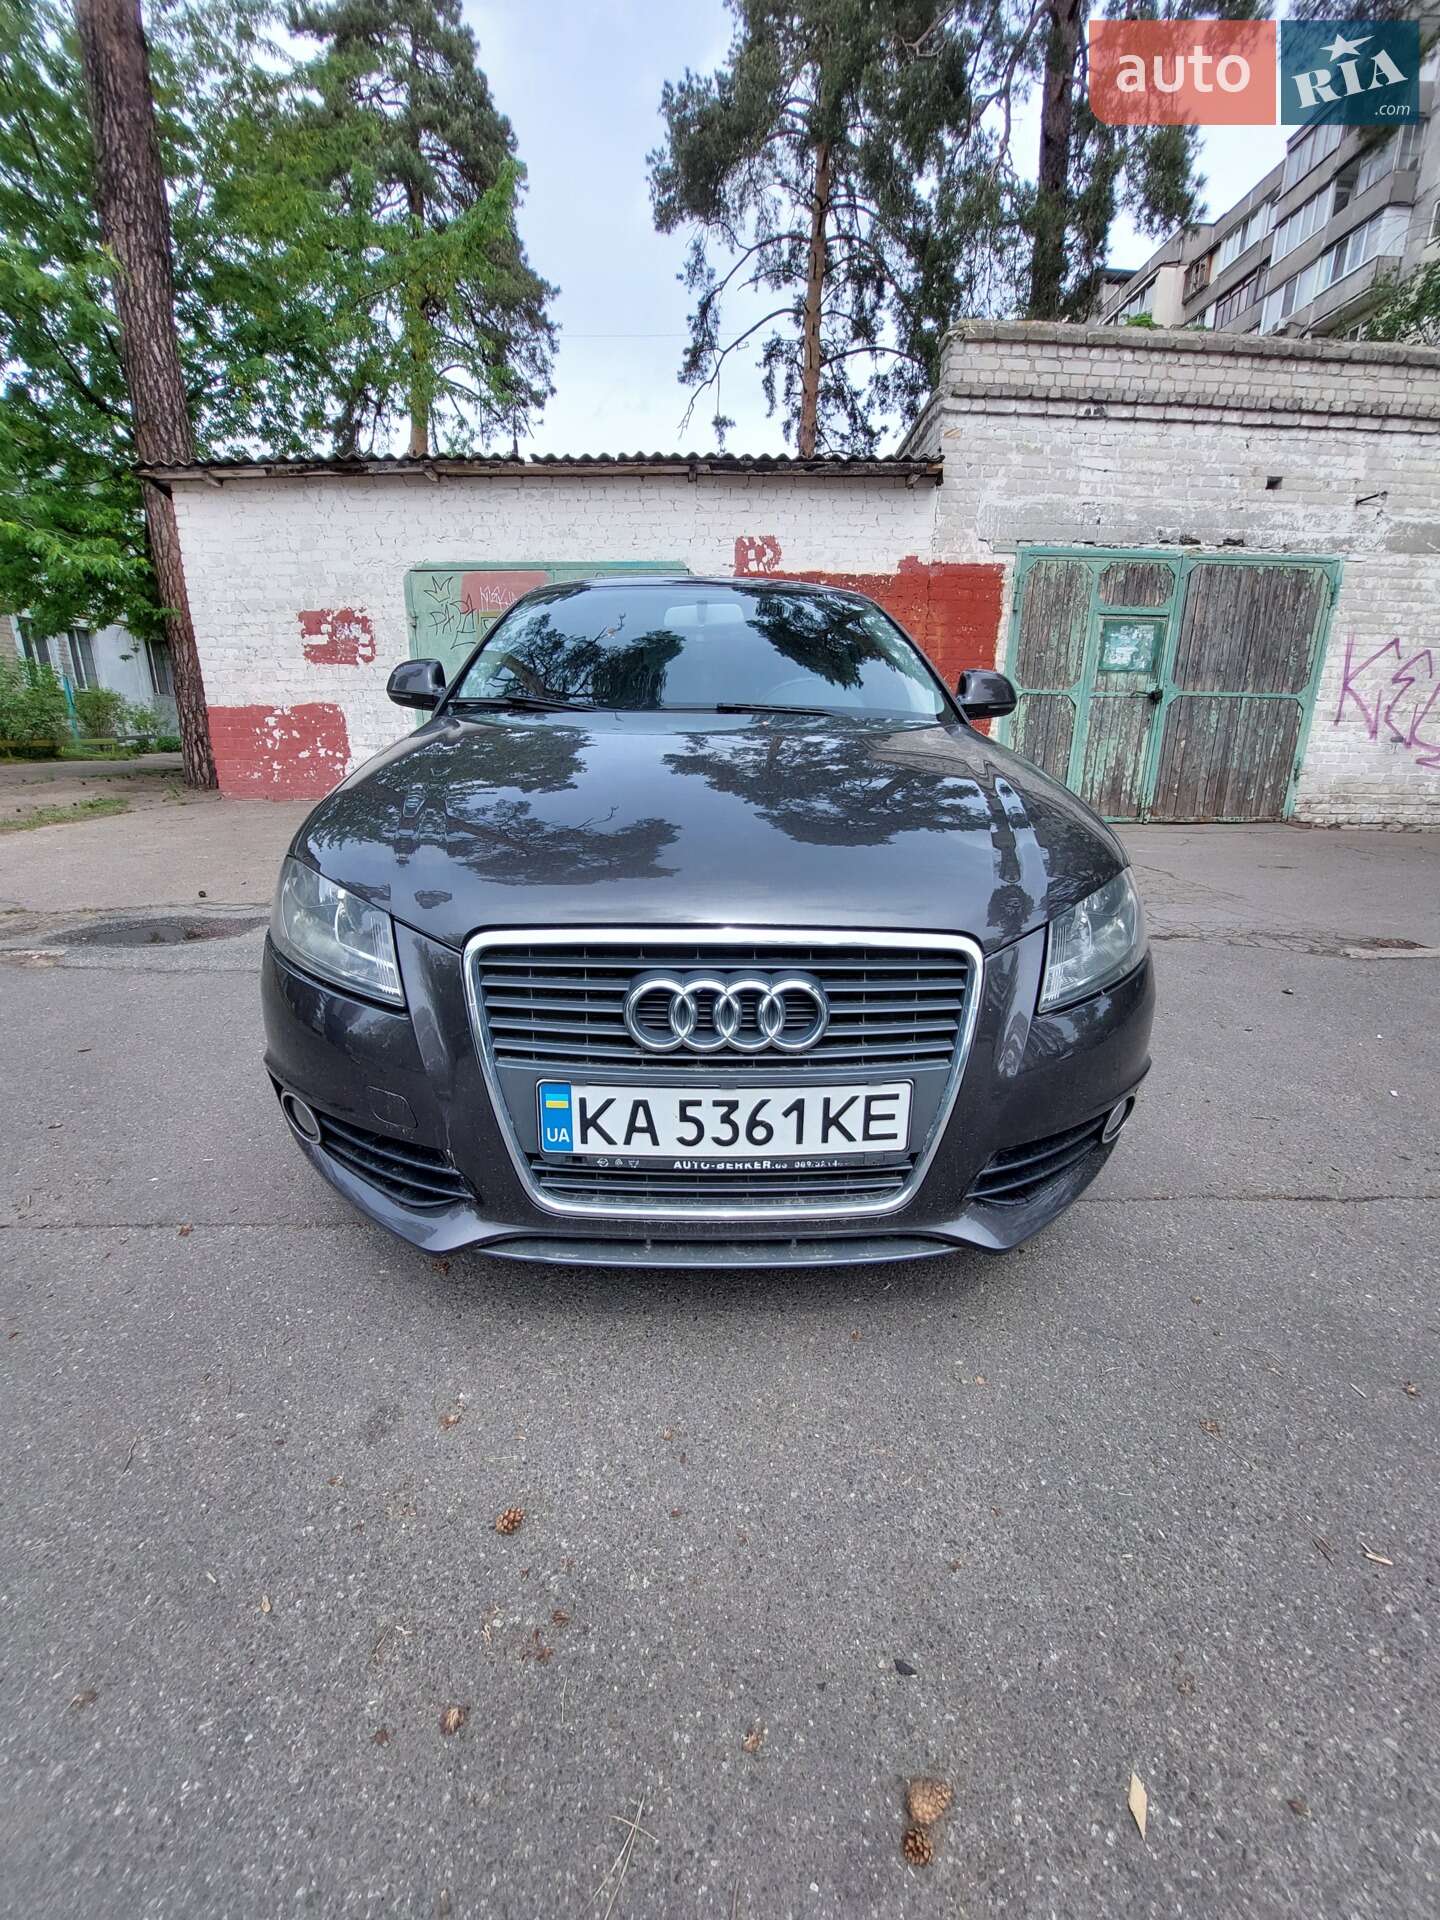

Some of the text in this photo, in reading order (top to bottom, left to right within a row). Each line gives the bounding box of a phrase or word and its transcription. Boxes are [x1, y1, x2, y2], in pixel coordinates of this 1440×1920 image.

[546, 1127, 570, 1143] UA
[578, 1093, 900, 1147] KA 5361 KE
